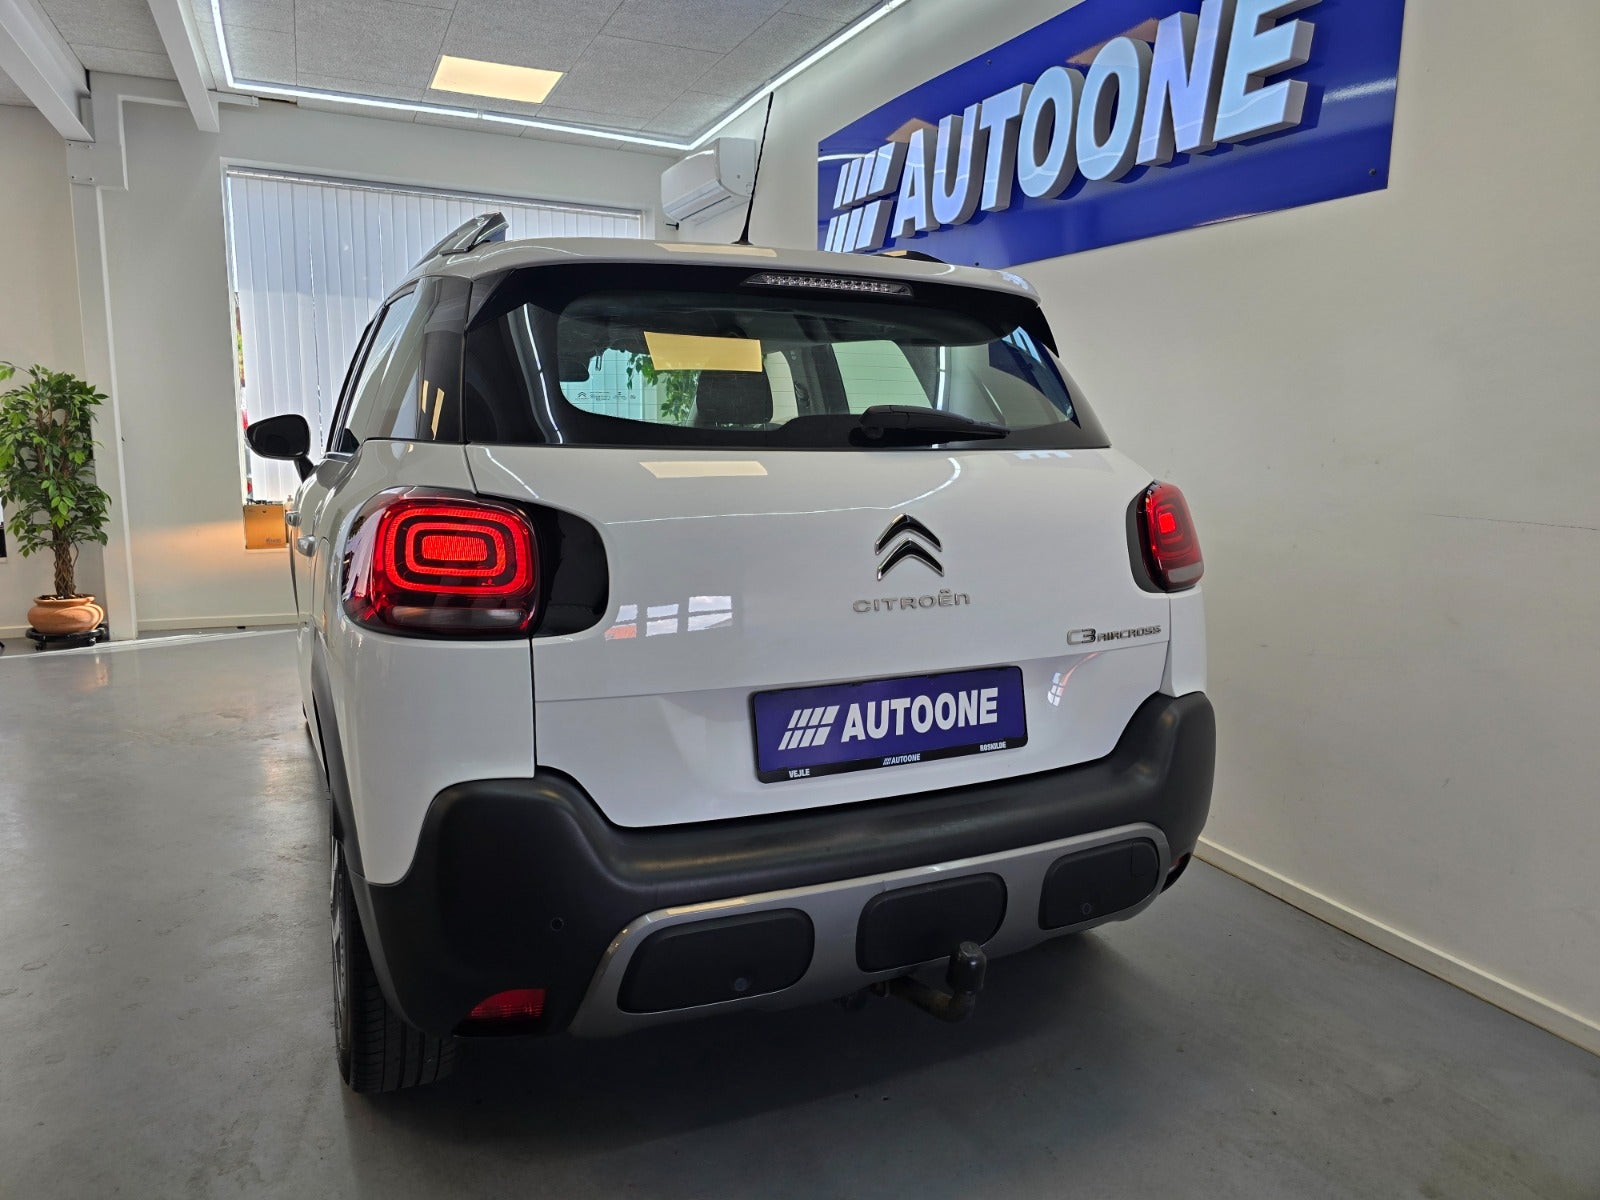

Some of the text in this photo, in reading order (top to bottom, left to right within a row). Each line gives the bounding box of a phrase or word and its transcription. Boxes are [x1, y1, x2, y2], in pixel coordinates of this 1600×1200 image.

[891, 0, 1314, 239] AUTOONE
[1066, 625, 1161, 645] C3 AIRCROSS
[841, 687, 998, 743] AUTOONE
[891, 753, 921, 765] AUTOONE
[789, 768, 811, 779] VEJLE
